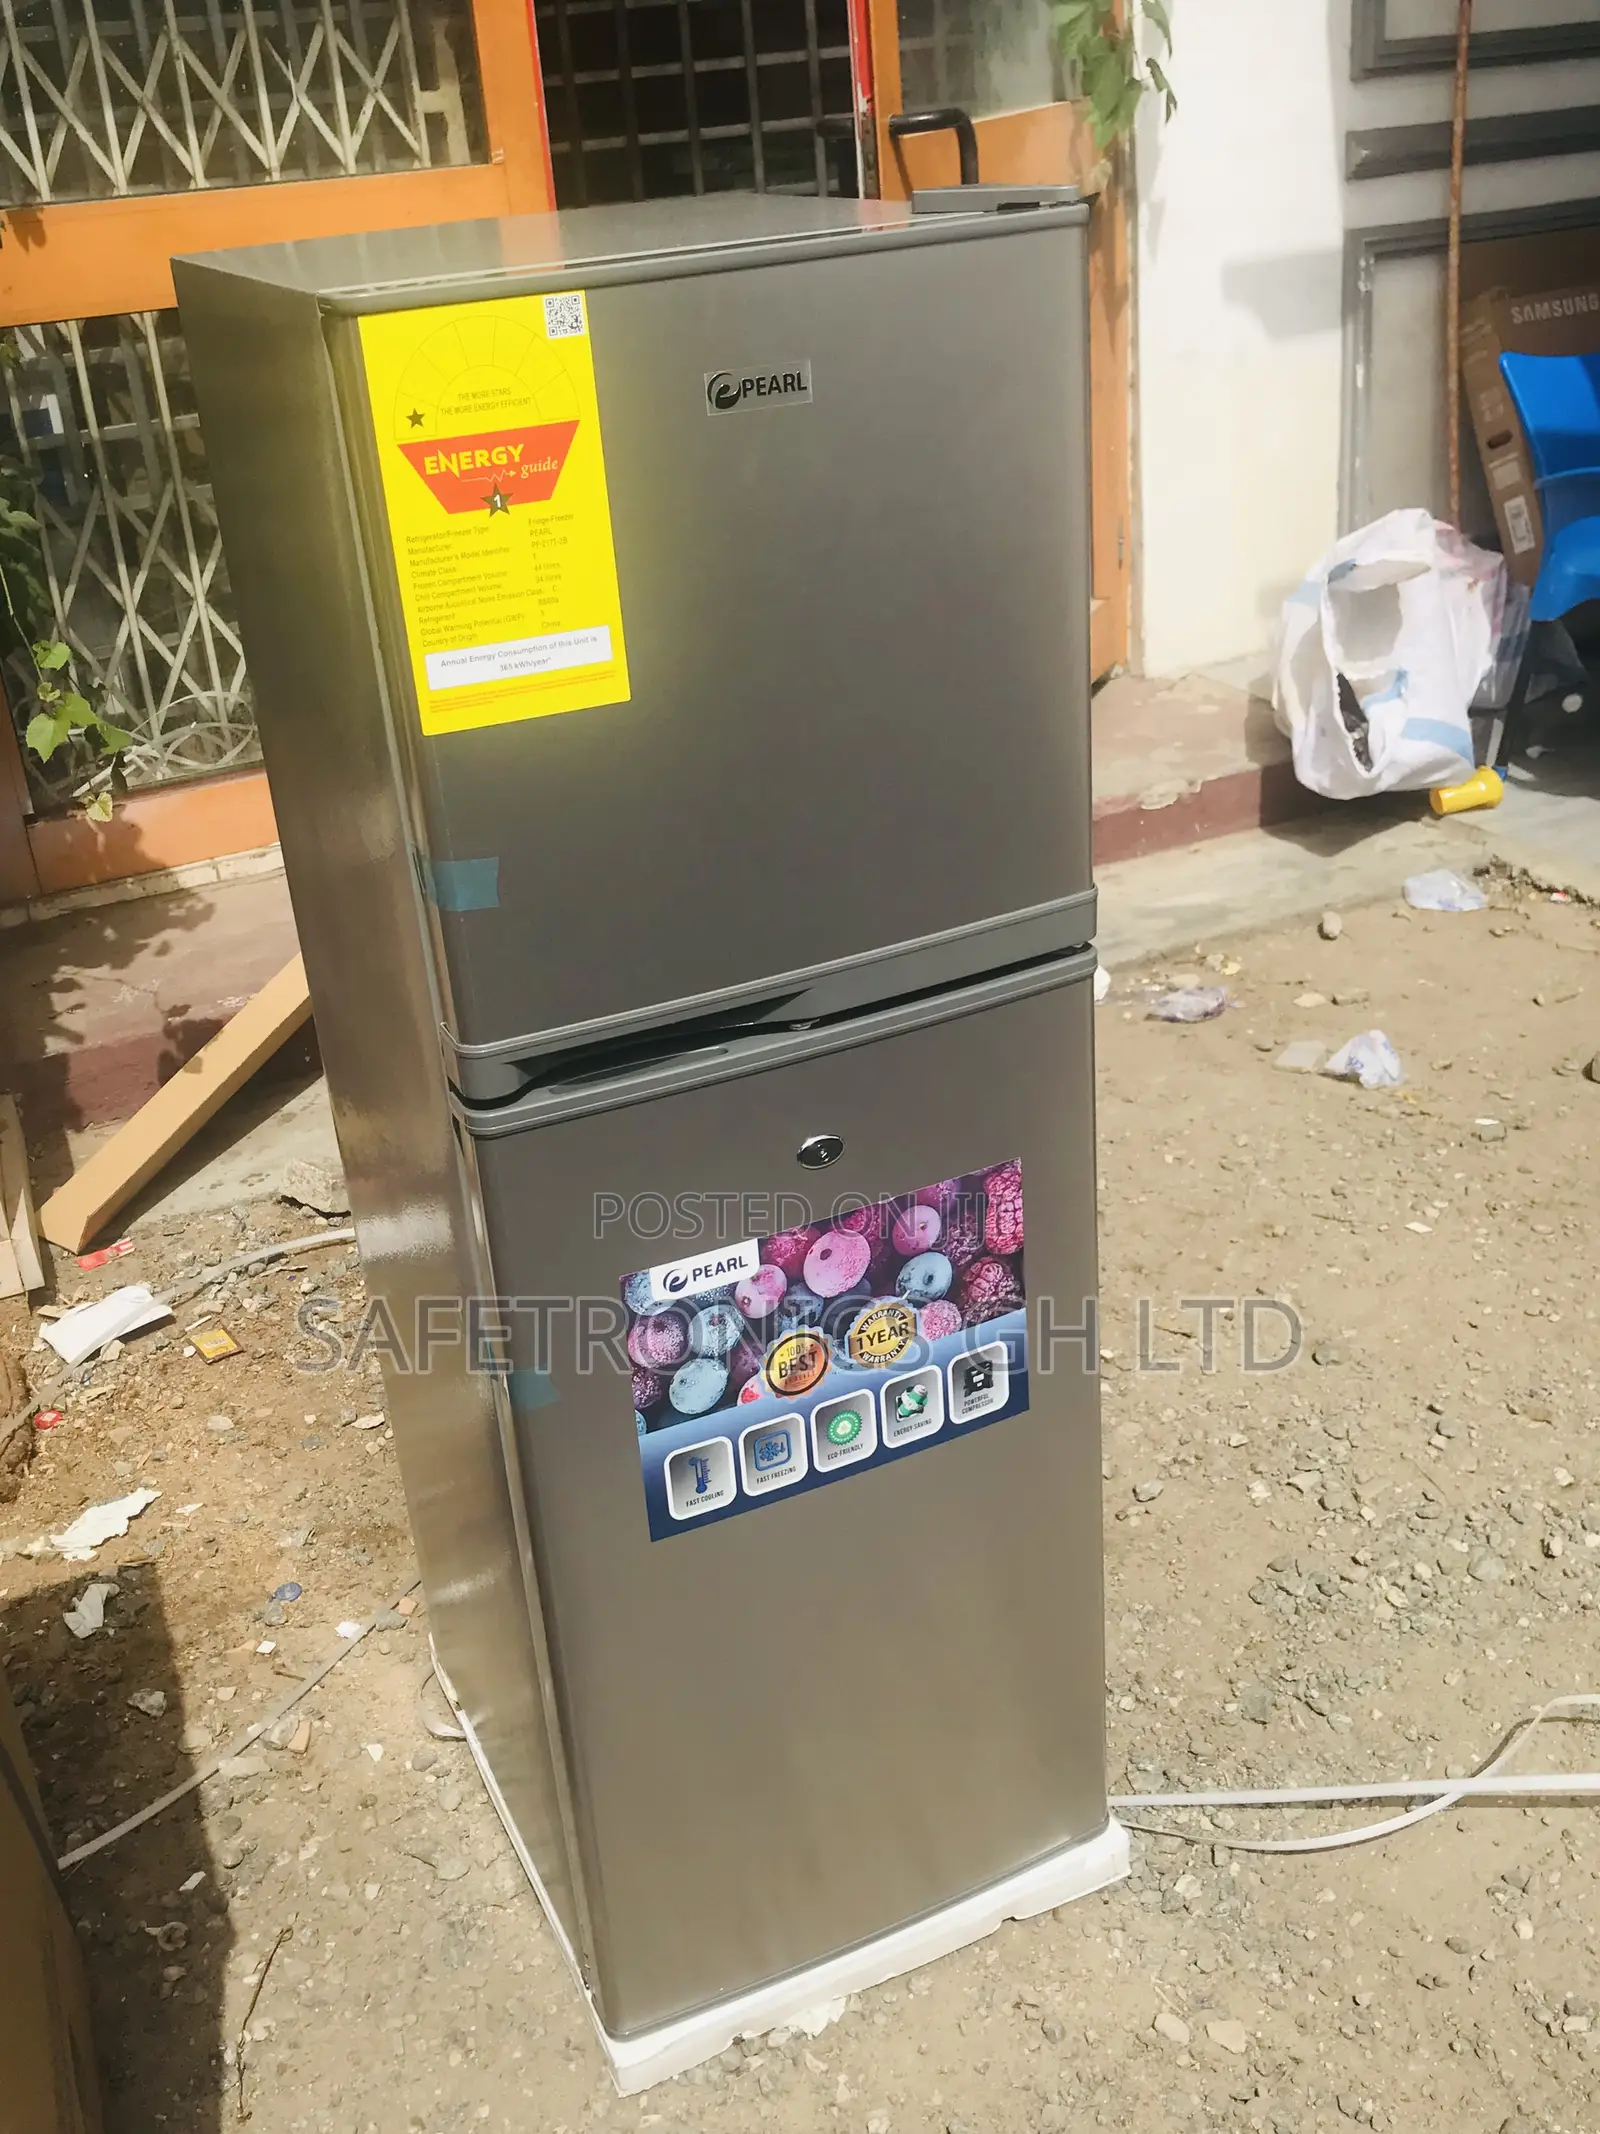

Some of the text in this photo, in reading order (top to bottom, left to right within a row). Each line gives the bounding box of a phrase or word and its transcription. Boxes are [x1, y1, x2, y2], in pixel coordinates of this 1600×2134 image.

[1510, 293, 1600, 324] SAMSUNG
[741, 371, 807, 398] PEARL
[458, 387, 512, 401] THE MORE STARS
[441, 397, 531, 416] THE MORE ENERGY EFFICIENT
[424, 444, 559, 478] ENERGY guide
[493, 493, 502, 508] 1
[530, 527, 552, 537] PEARL
[461, 550, 481, 559] Model
[412, 568, 437, 579] Climate
[421, 626, 442, 635] Global
[443, 622, 472, 634] Warming
[542, 620, 561, 629] China
[423, 637, 450, 649] Country
[441, 657, 467, 667] Annual
[469, 652, 497, 664] Energy
[497, 644, 548, 659] Consumption
[558, 640, 572, 648] this
[573, 637, 589, 645] Unit
[500, 663, 513, 672] 365
[692, 1256, 748, 1281] PEARL
[861, 1309, 904, 1332] WARRANTY
[856, 1321, 910, 1350] 1 YEAR
[862, 1340, 906, 1363] WARRANTY
[778, 1350, 818, 1379] BEST
[962, 1398, 994, 1415] COMPRESSOR
[964, 1393, 989, 1407] POWERFUL
[893, 1418, 933, 1437] ENERGY SAVING
[827, 1443, 864, 1460] ECO-FRIENDLY
[756, 1466, 797, 1485] FAST FREEZING
[686, 1490, 724, 1507] FAST COOLING
